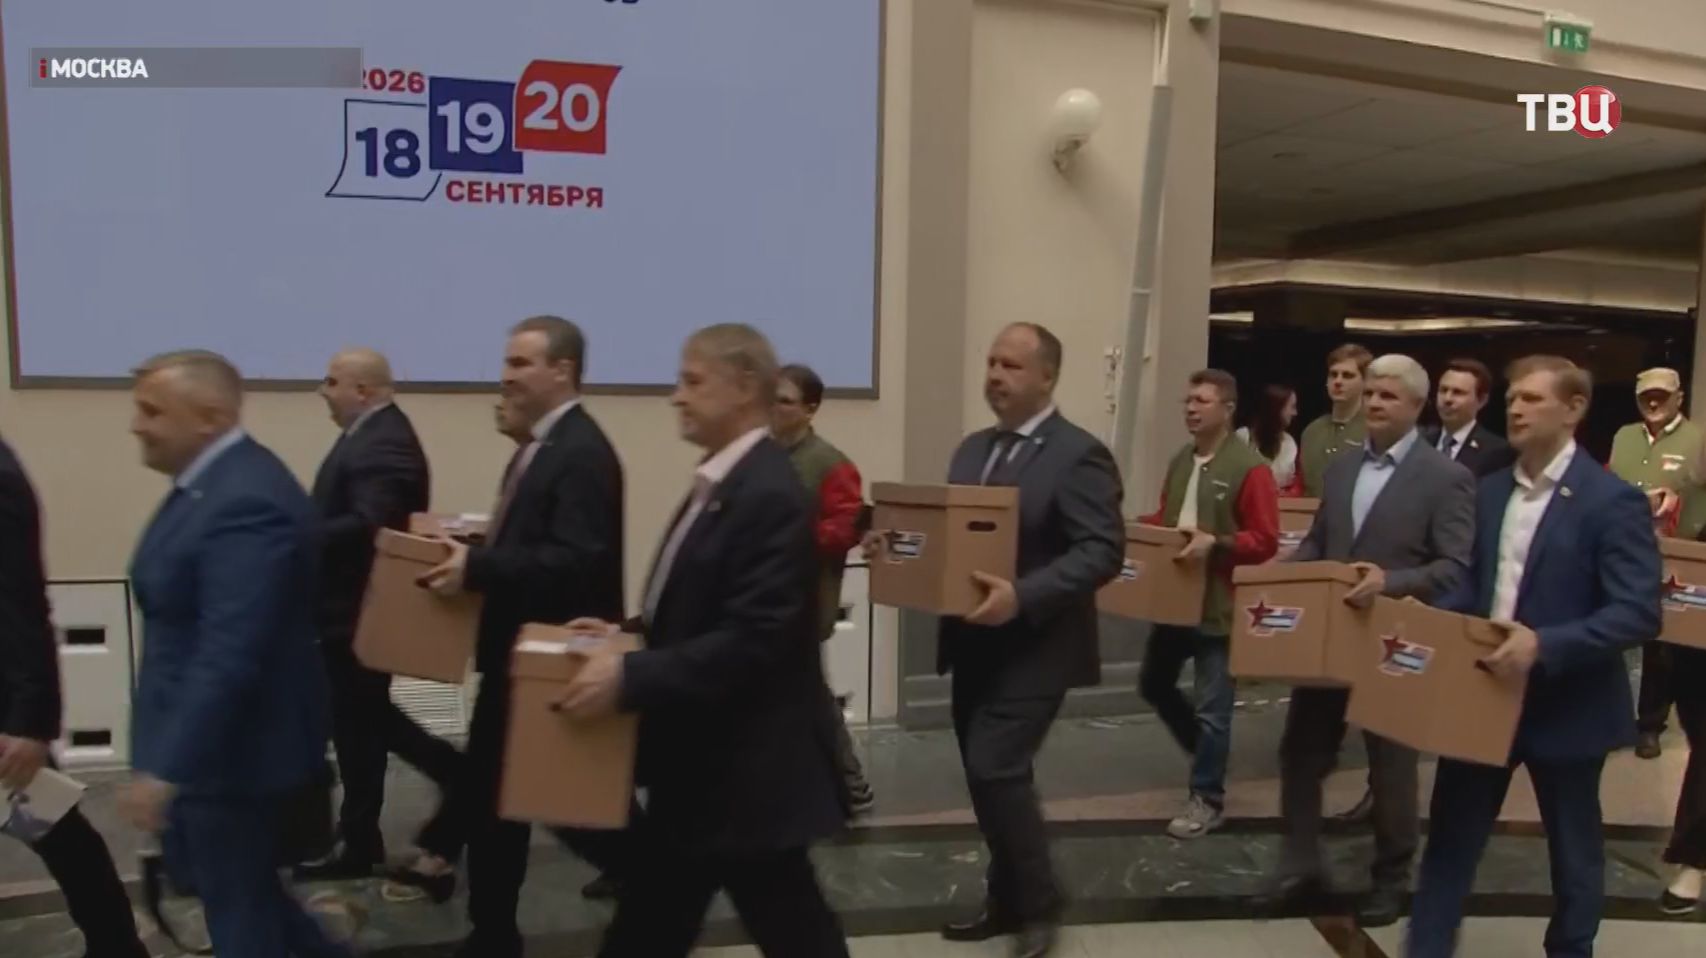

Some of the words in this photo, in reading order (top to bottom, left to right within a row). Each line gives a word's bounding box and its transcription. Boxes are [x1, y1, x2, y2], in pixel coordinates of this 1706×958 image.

[363, 69, 425, 93] 026
[355, 127, 421, 178] 18
[437, 100, 505, 154] 19
[523, 81, 600, 132] 20
[445, 180, 604, 208] СЕНТЯБРЯ
